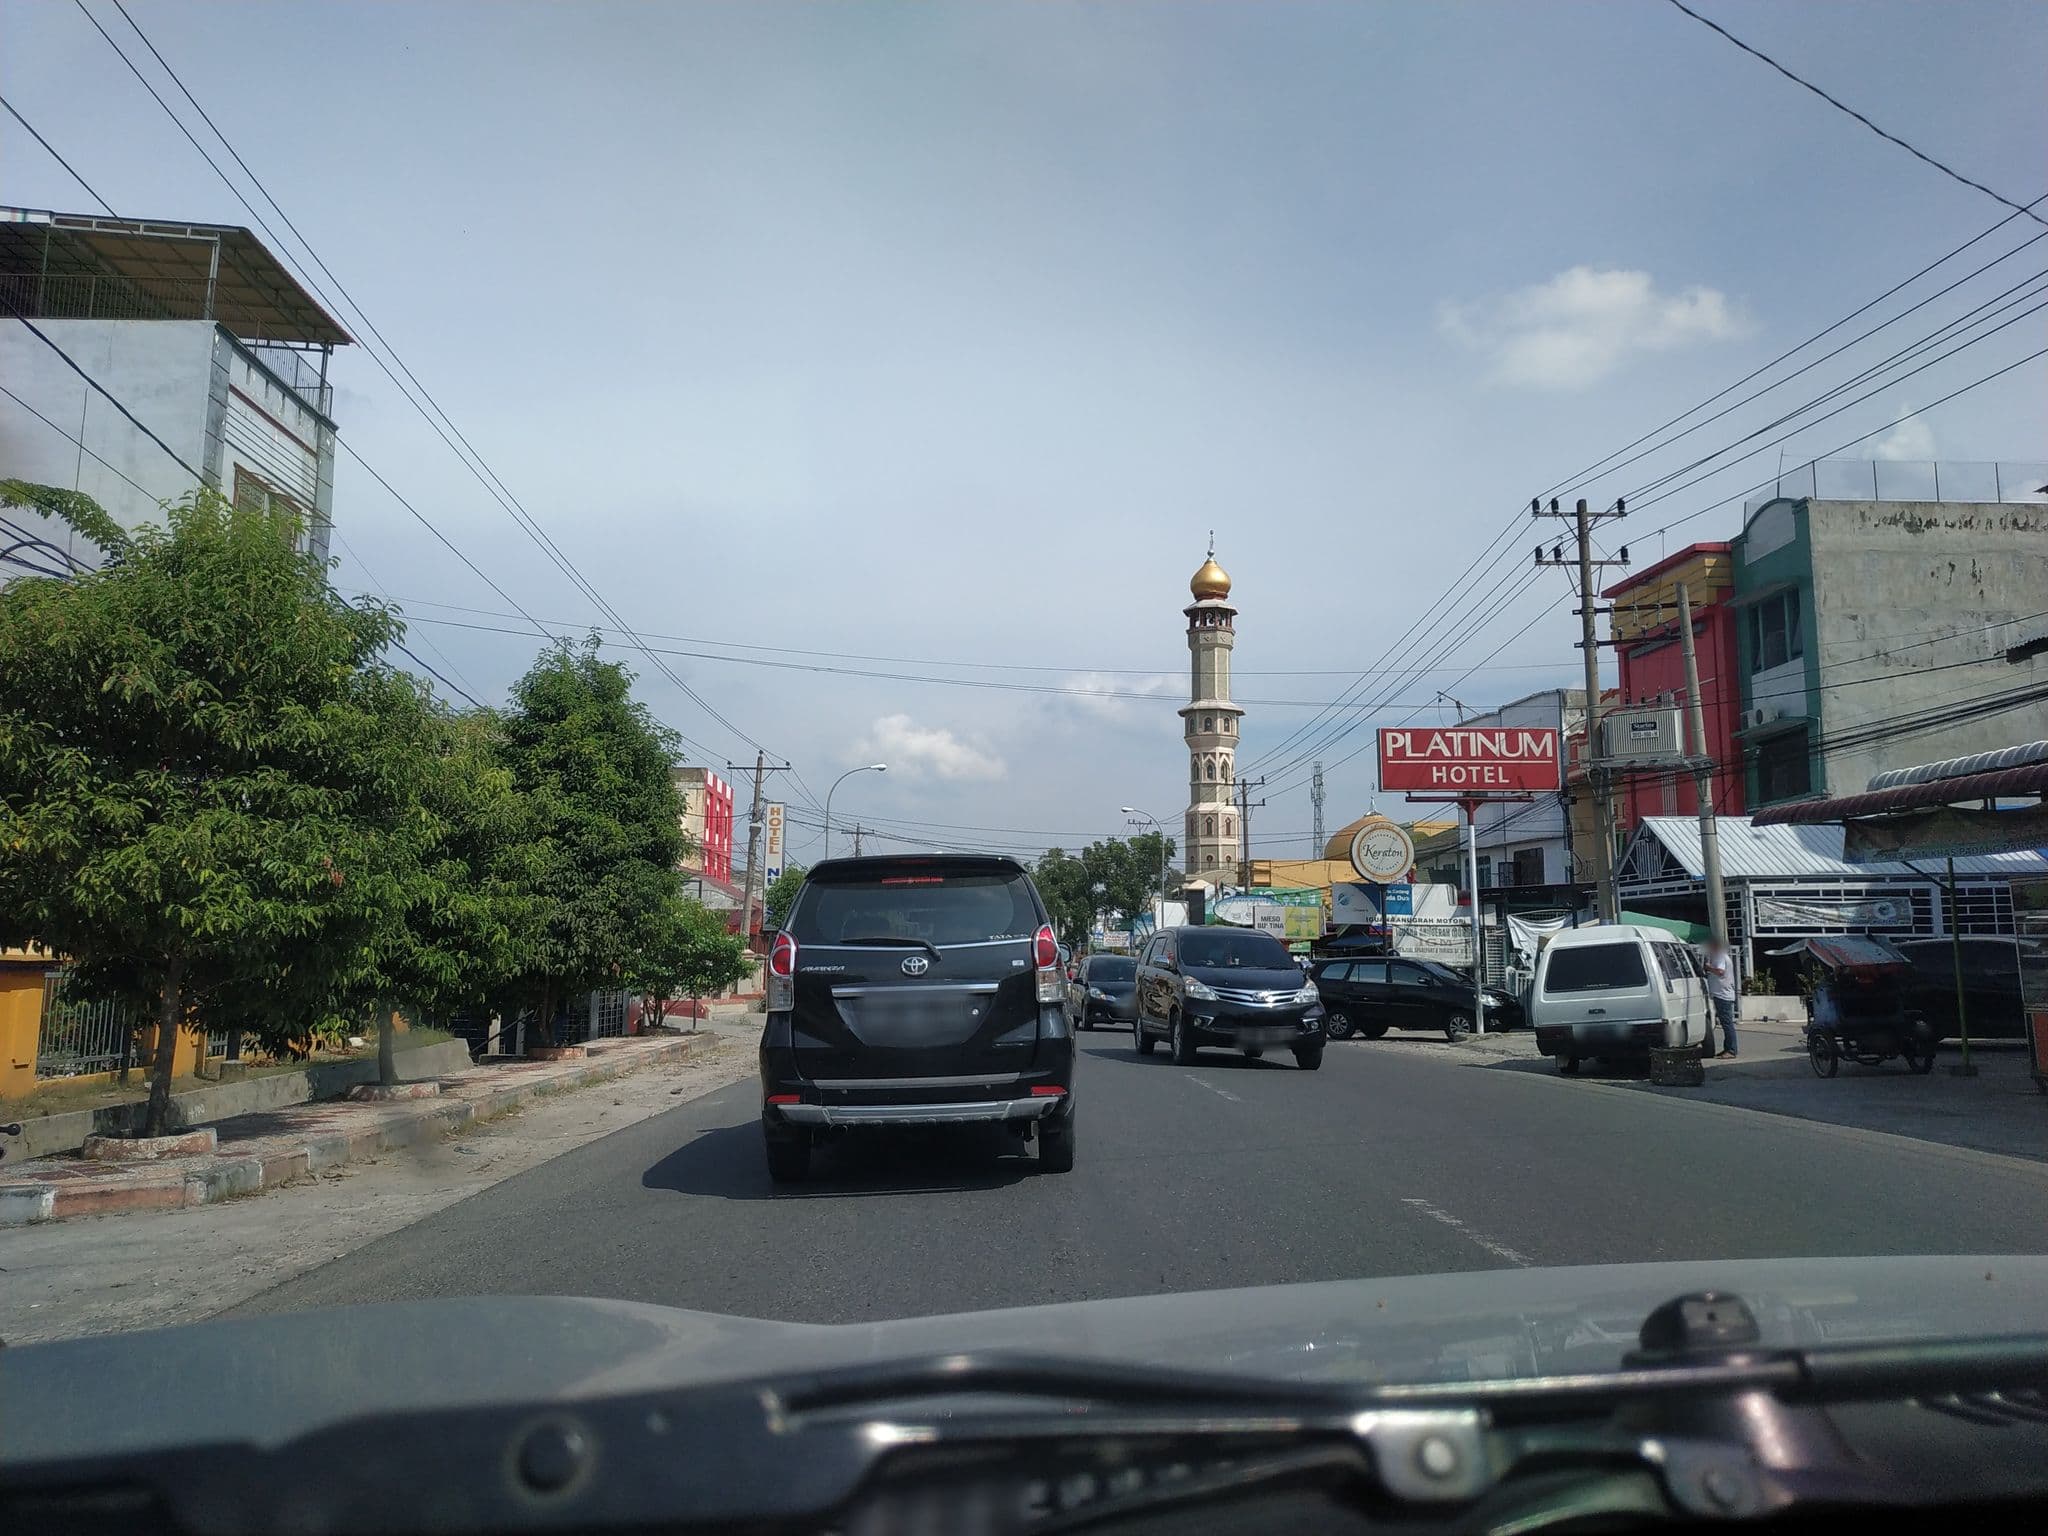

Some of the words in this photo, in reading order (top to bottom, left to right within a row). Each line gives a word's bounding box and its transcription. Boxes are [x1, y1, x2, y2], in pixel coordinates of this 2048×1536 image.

[1386, 732, 1553, 758] PLATINUM
[1432, 766, 1510, 784] HOTEL
[769, 807, 781, 854] HOTEL
[1363, 844, 1403, 860] Keraton
